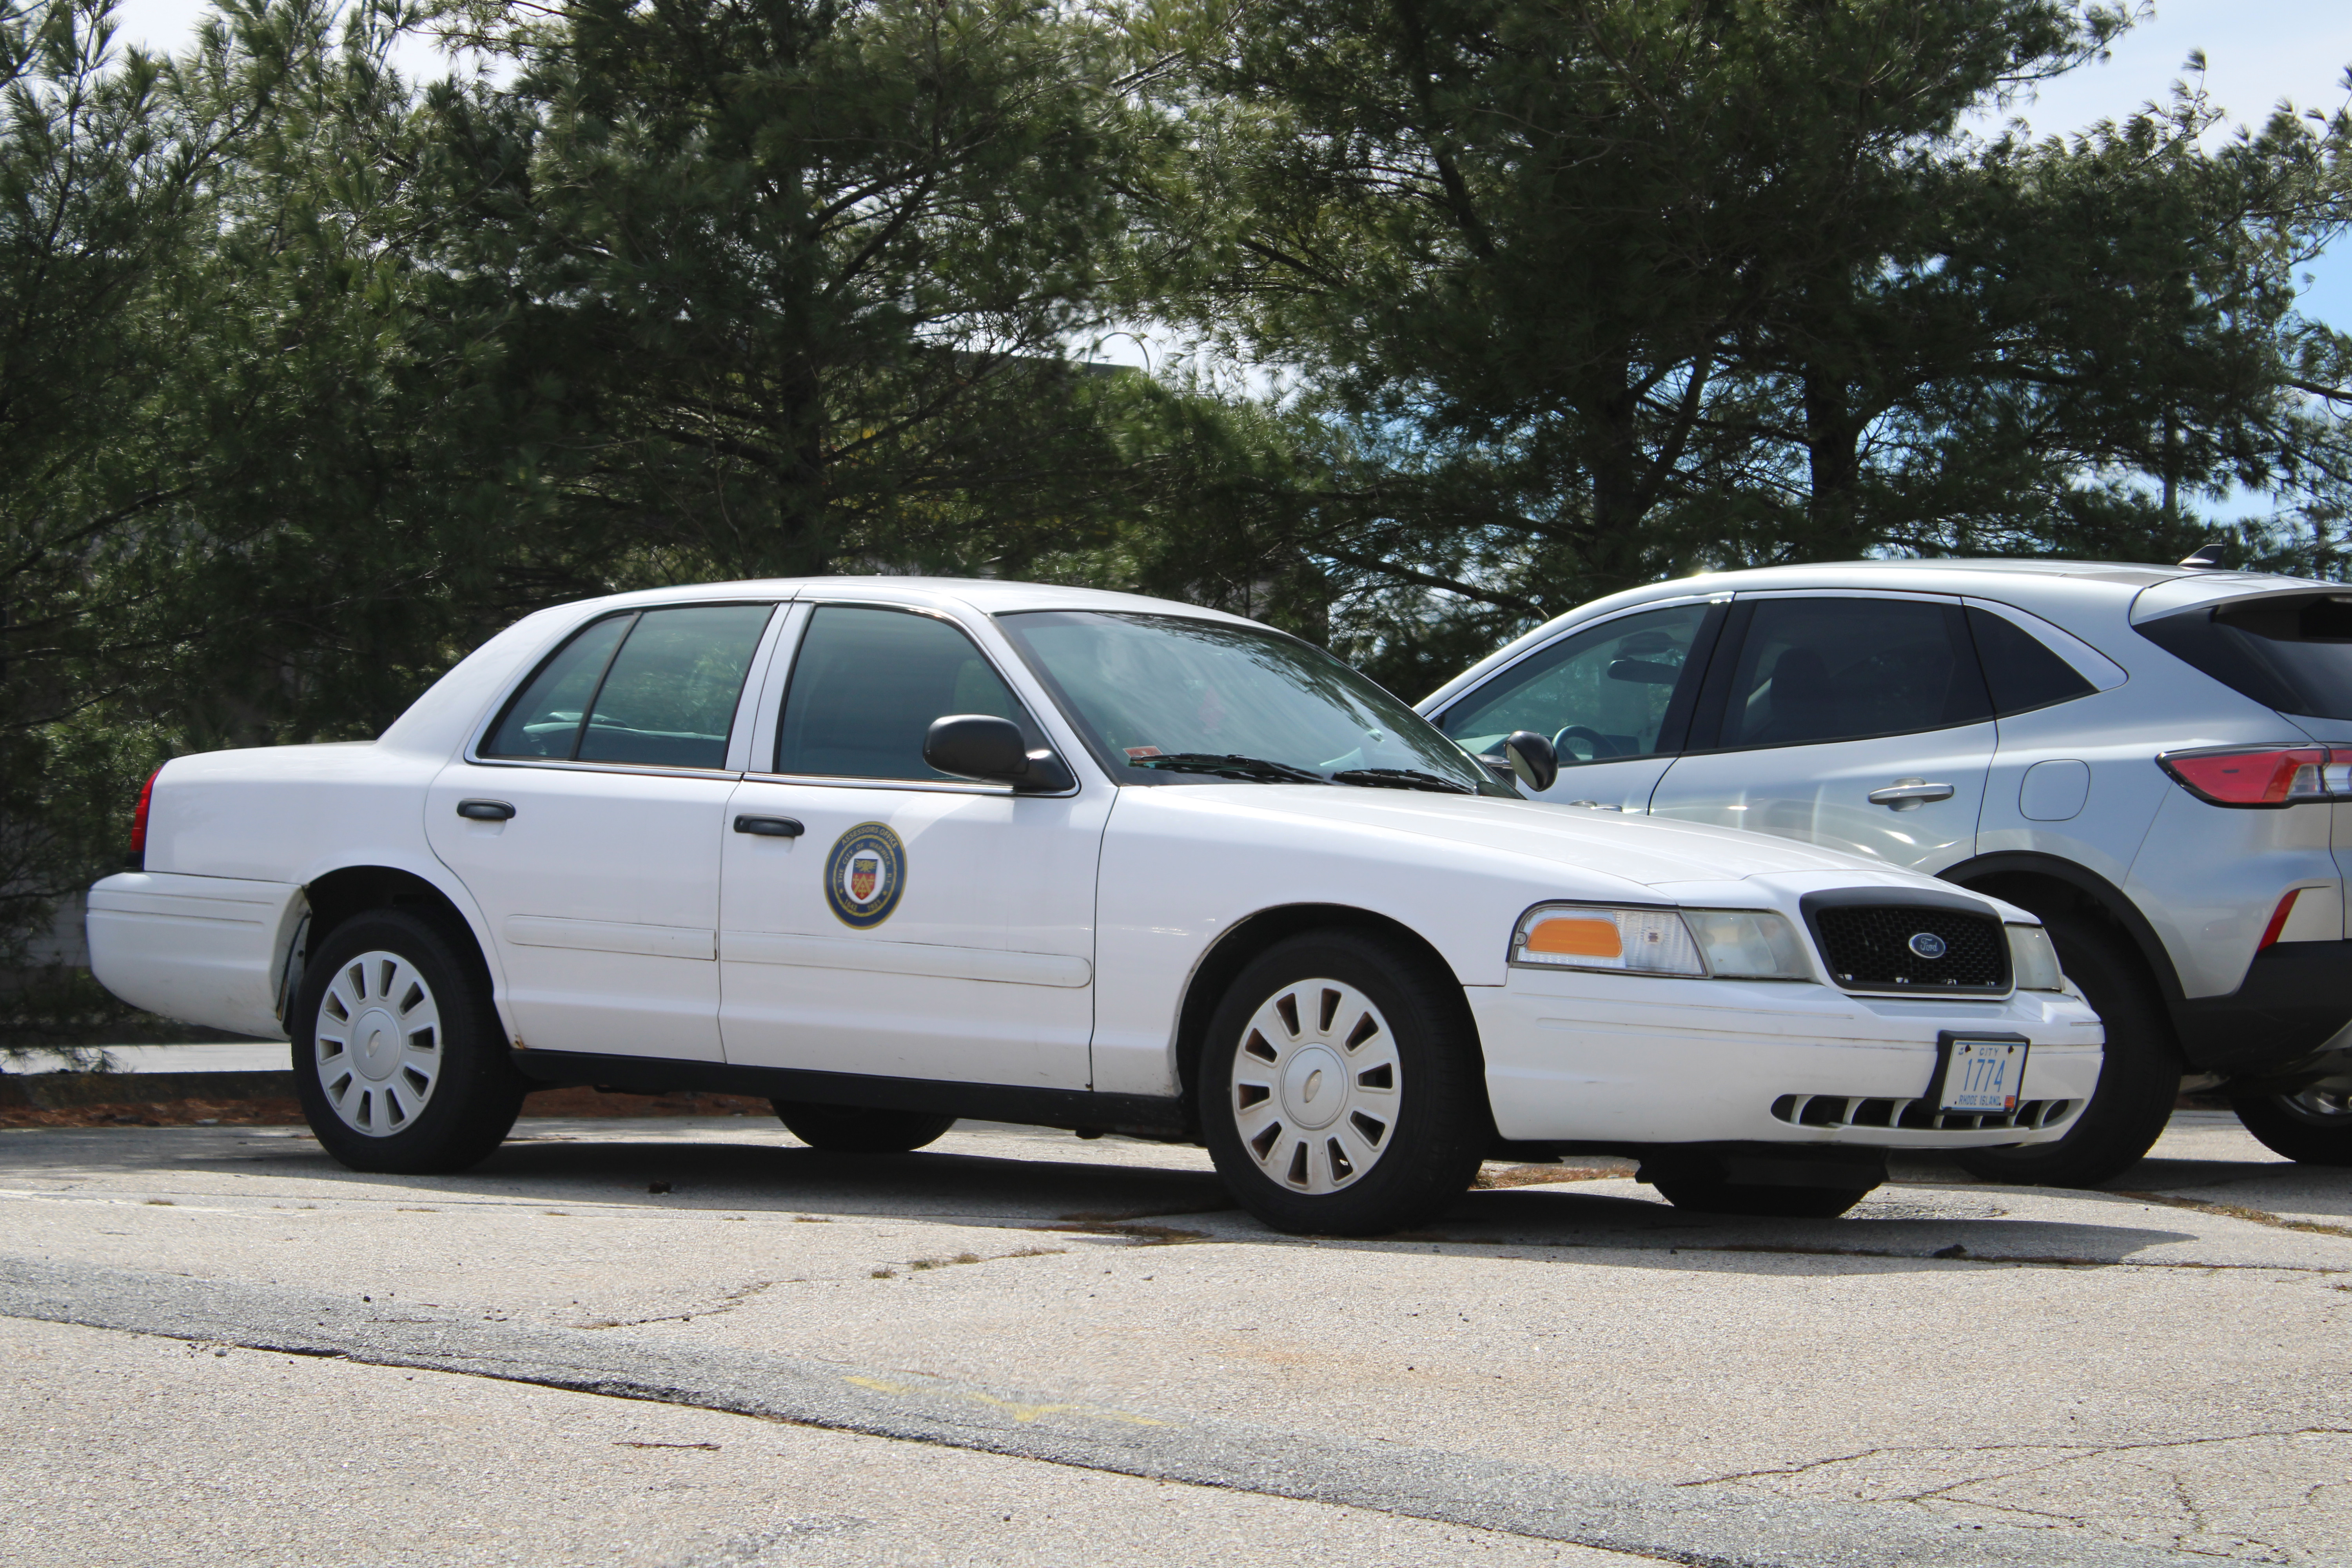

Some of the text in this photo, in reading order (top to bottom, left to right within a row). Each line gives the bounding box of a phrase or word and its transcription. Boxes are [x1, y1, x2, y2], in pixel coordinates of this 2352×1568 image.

[842, 826, 898, 848] ASSESSORS OFFICE
[842, 849, 853, 864] CITY
[1920, 938, 1938, 951] Ford
[1979, 1047, 2000, 1056] CITY
[1964, 1058, 2006, 1093] 1774
[1958, 1094, 1978, 1105] RHODE
[1980, 1095, 2000, 1105] ISLAND
